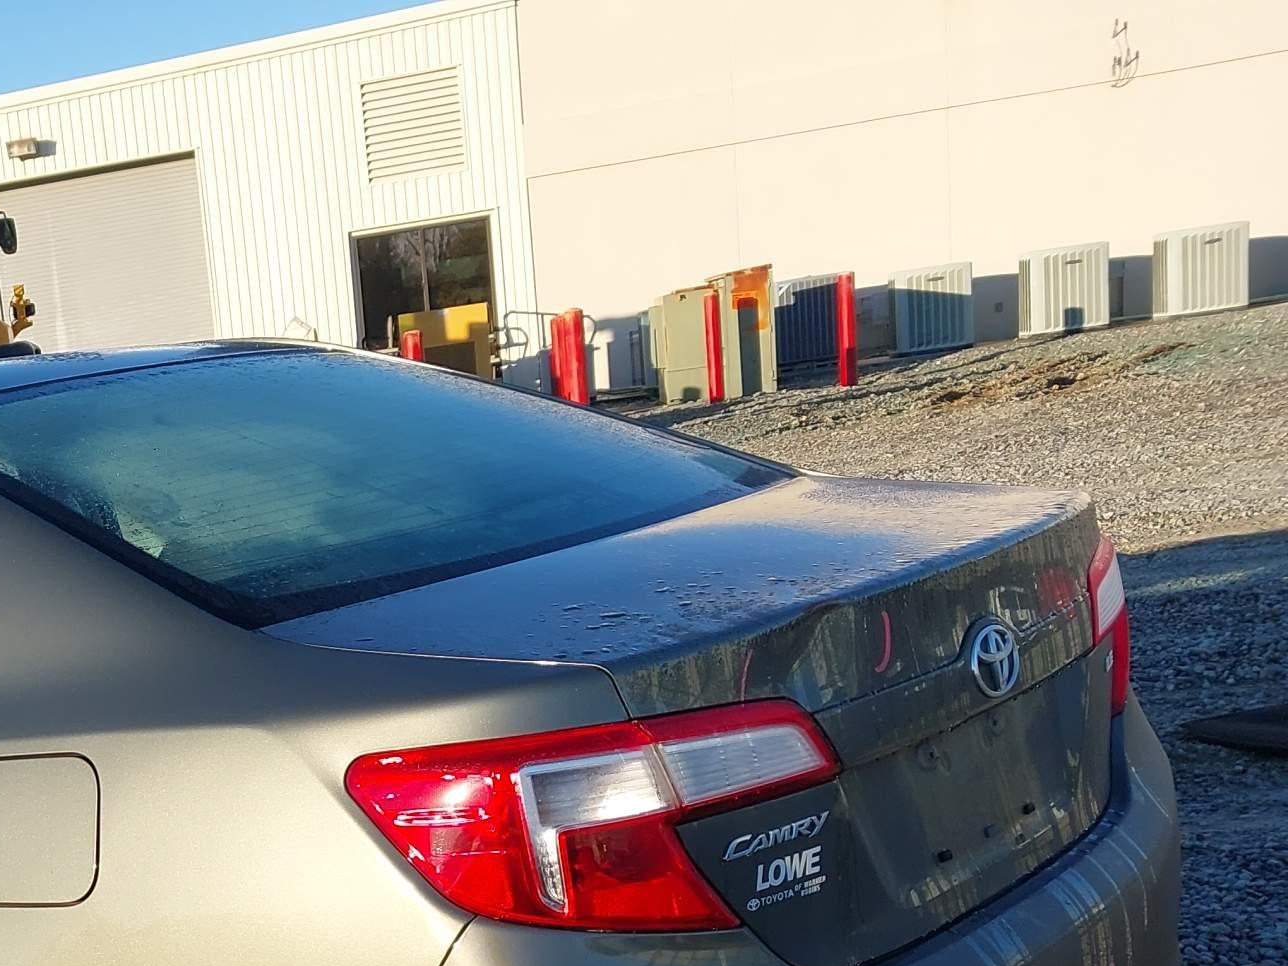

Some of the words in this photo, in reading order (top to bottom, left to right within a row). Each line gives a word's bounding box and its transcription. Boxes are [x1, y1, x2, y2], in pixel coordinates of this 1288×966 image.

[722, 810, 830, 861] CAMRY
[756, 845, 822, 892] LOWE
[761, 888, 794, 906] TOYOTA
